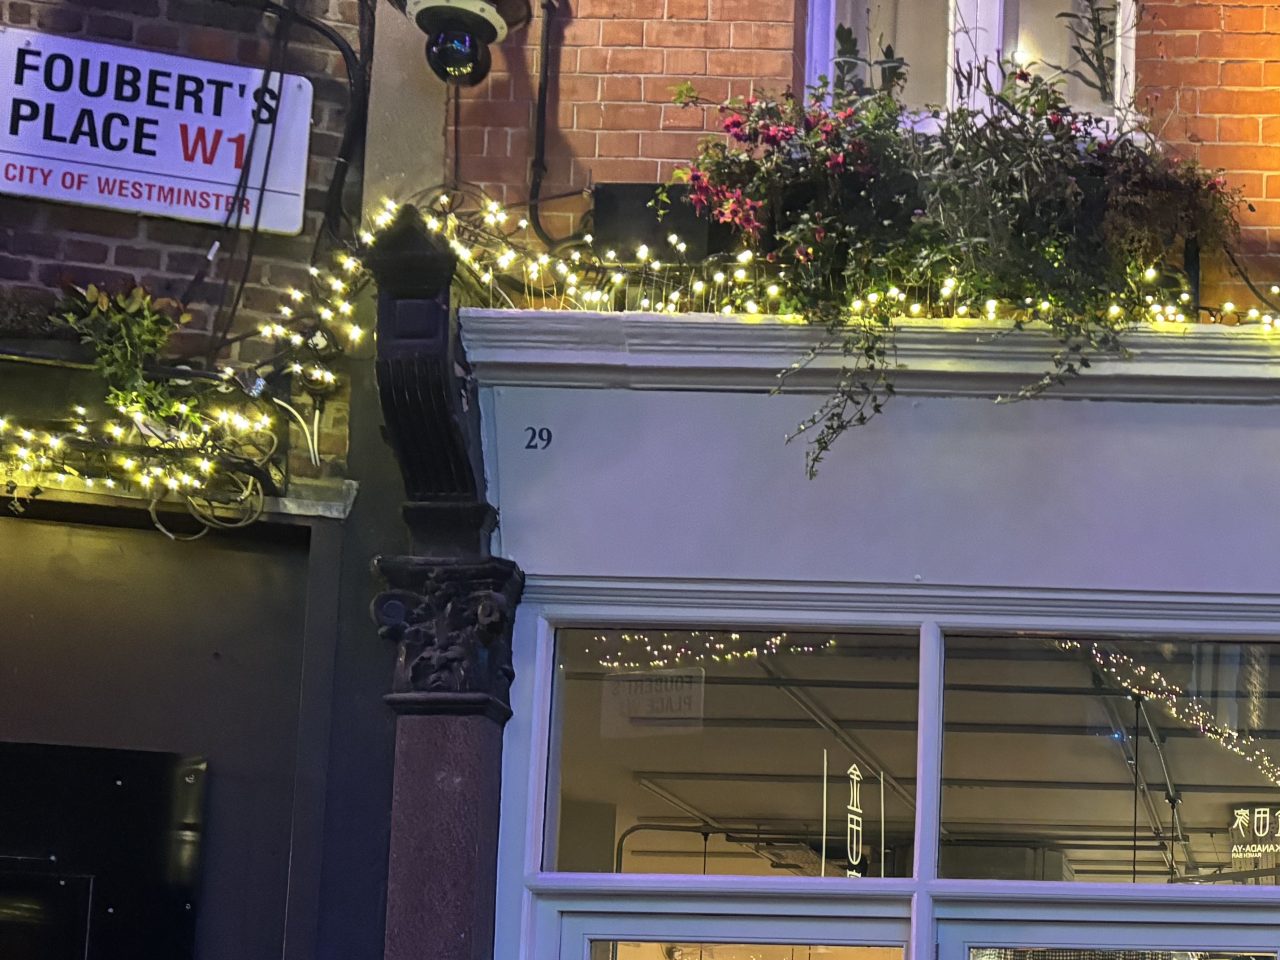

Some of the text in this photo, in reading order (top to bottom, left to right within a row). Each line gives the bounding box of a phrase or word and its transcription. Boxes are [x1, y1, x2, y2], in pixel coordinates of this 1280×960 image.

[14, 47, 279, 125] FOUBERT'S
[9, 98, 248, 170] PLACE W1
[4, 162, 251, 216] CITY OF WESTMINSTER
[524, 426, 553, 450] 29
